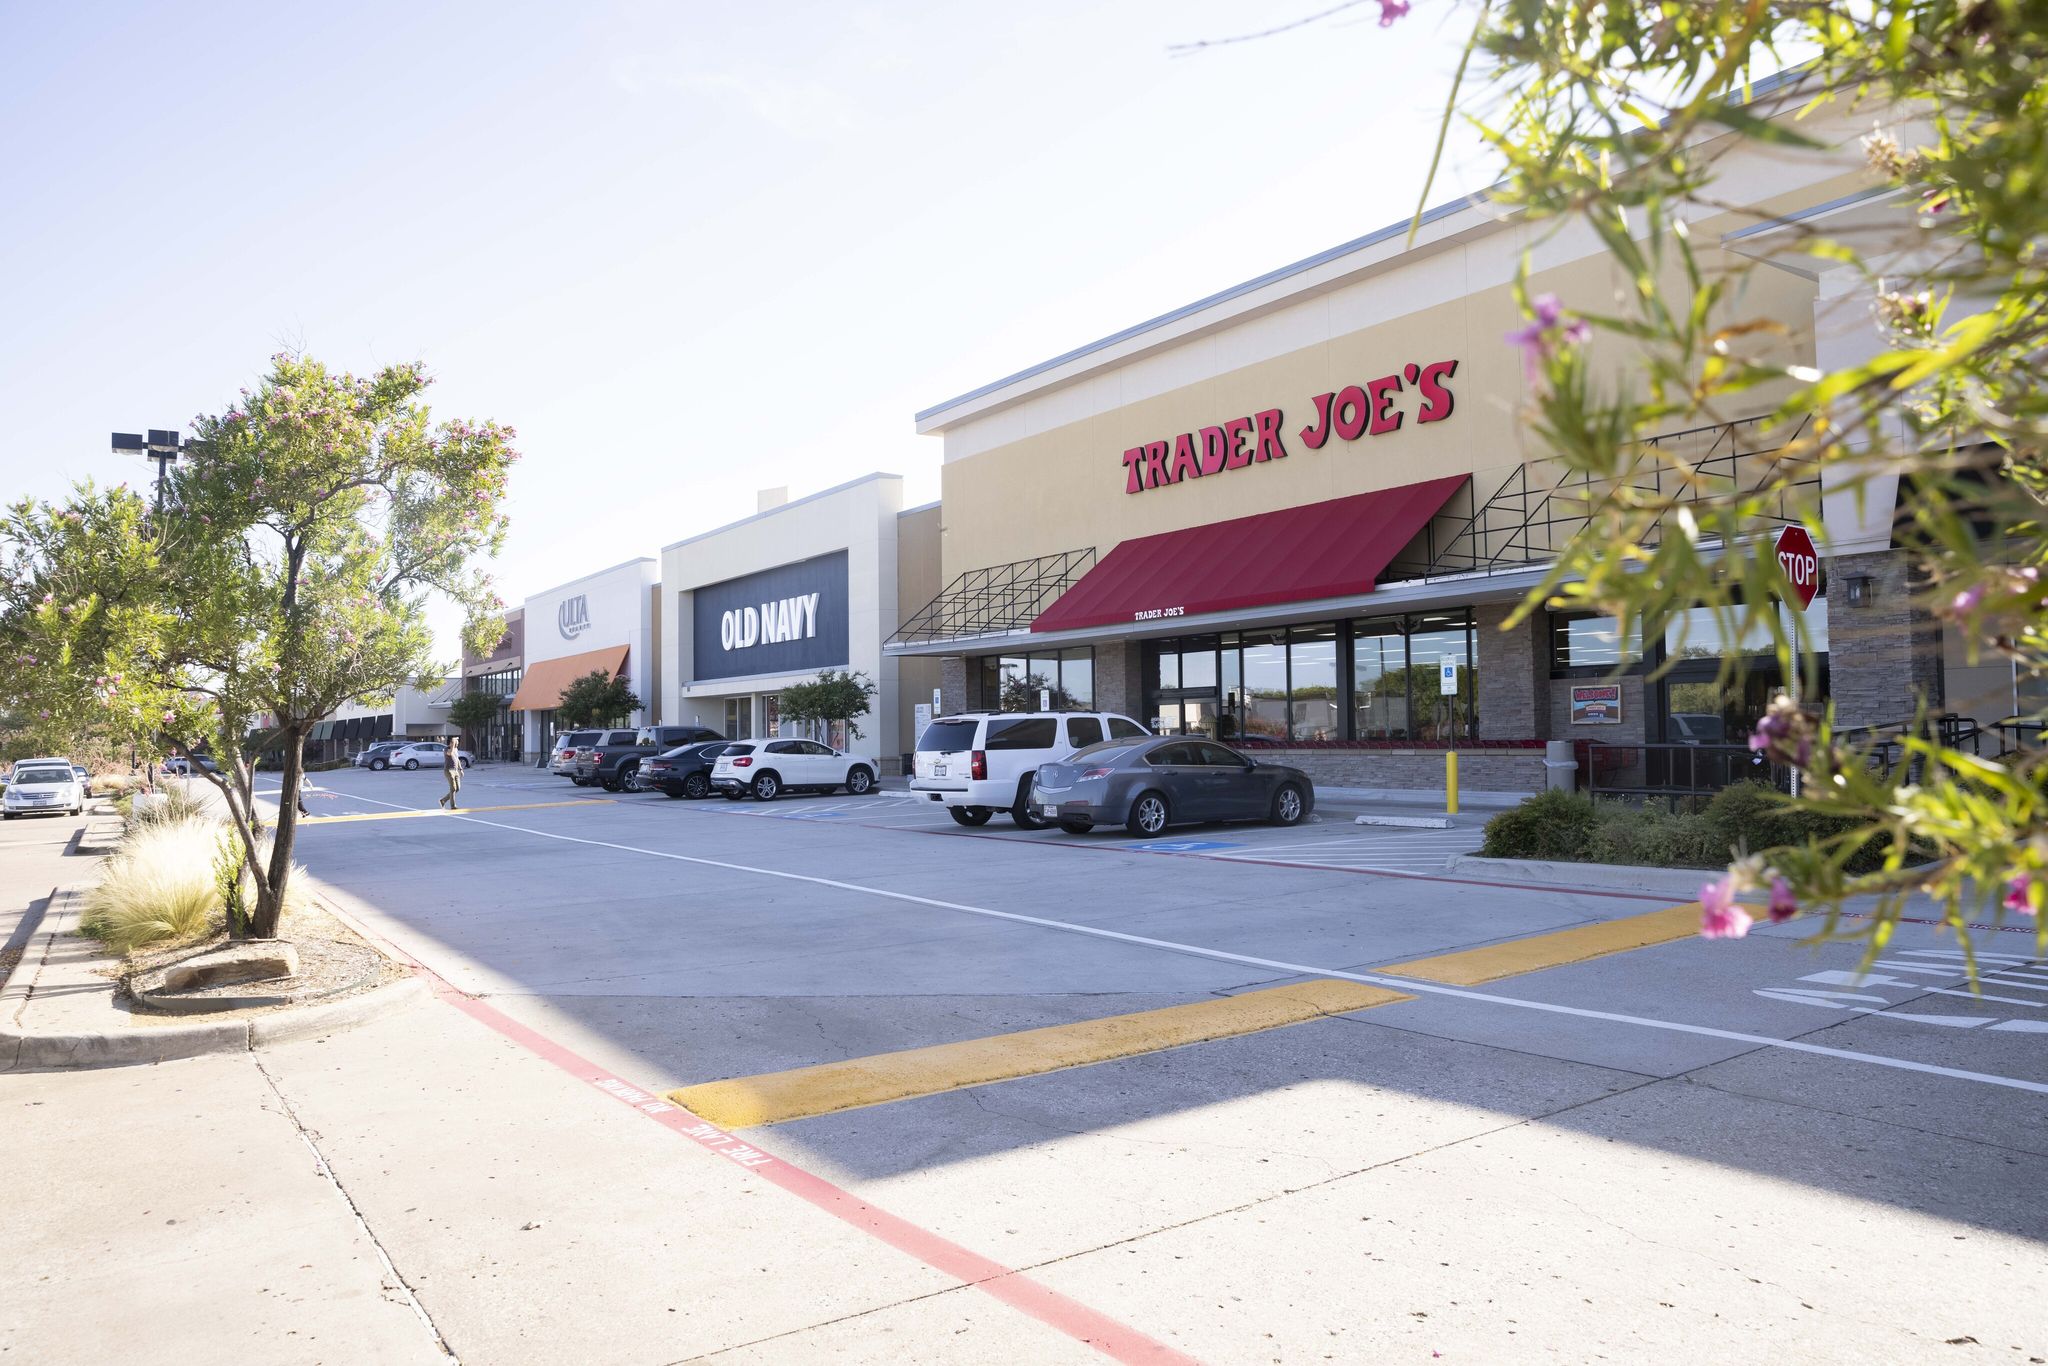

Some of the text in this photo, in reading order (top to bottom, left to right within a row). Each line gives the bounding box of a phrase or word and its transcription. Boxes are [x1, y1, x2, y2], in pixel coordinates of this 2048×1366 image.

[1122, 360, 1459, 494] TRADER JOE'S
[1777, 550, 1815, 586] STOP
[561, 594, 589, 627] ULTA
[721, 592, 820, 651] OLD NAVY
[1134, 606, 1184, 620] TRADER JOE'S
[682, 1124, 734, 1146] LANE
[720, 1145, 773, 1166] FIRE
